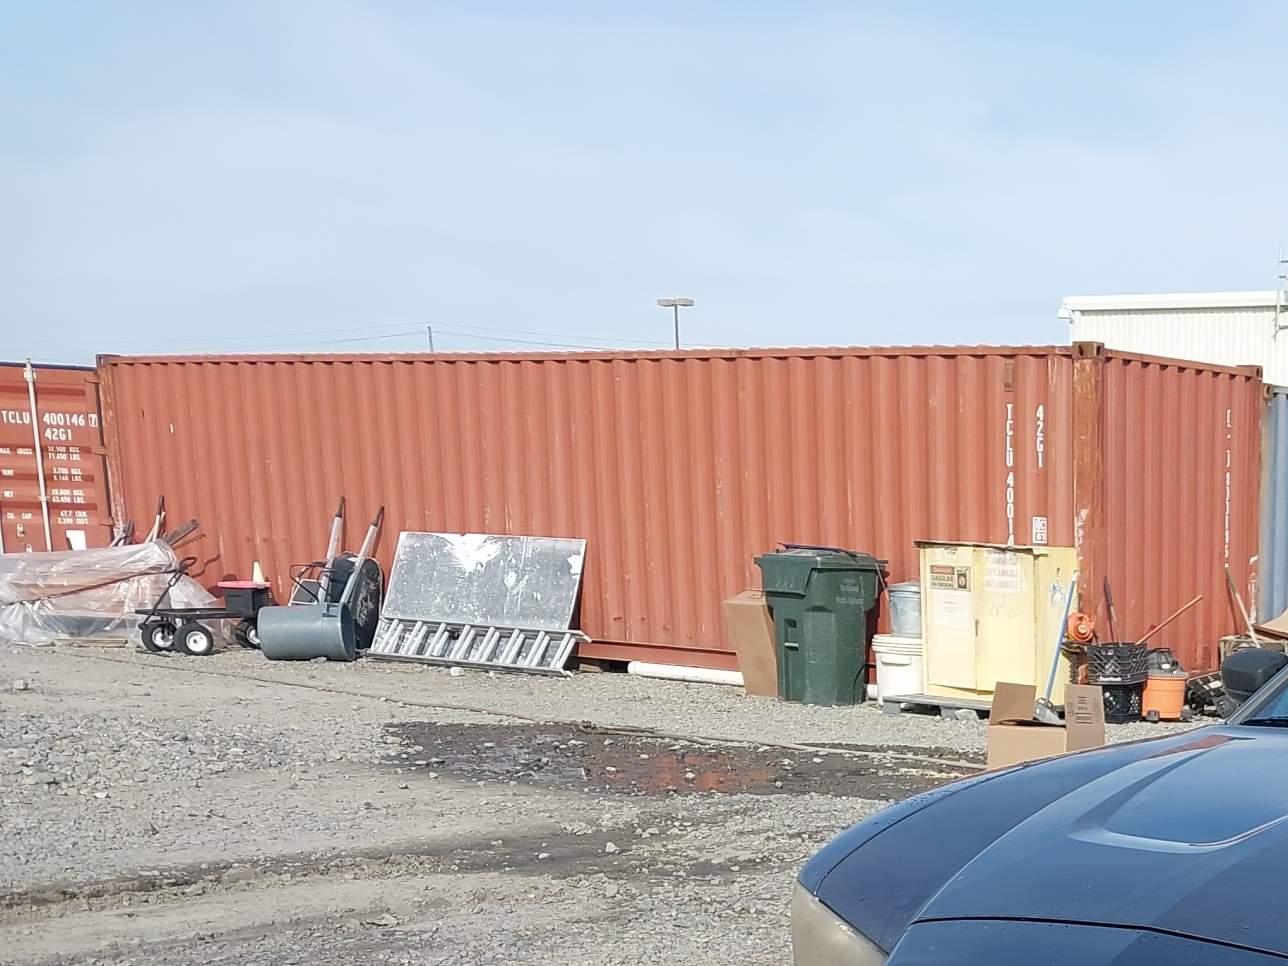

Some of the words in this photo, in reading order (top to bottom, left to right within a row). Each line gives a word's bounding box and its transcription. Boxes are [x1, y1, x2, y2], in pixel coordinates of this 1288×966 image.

[1, 411, 30, 424] TCLU
[43, 412, 85, 426] 400146
[45, 428, 72, 440] 42G1
[1006, 403, 1014, 467] TCLU
[1036, 405, 1044, 468] 42G1
